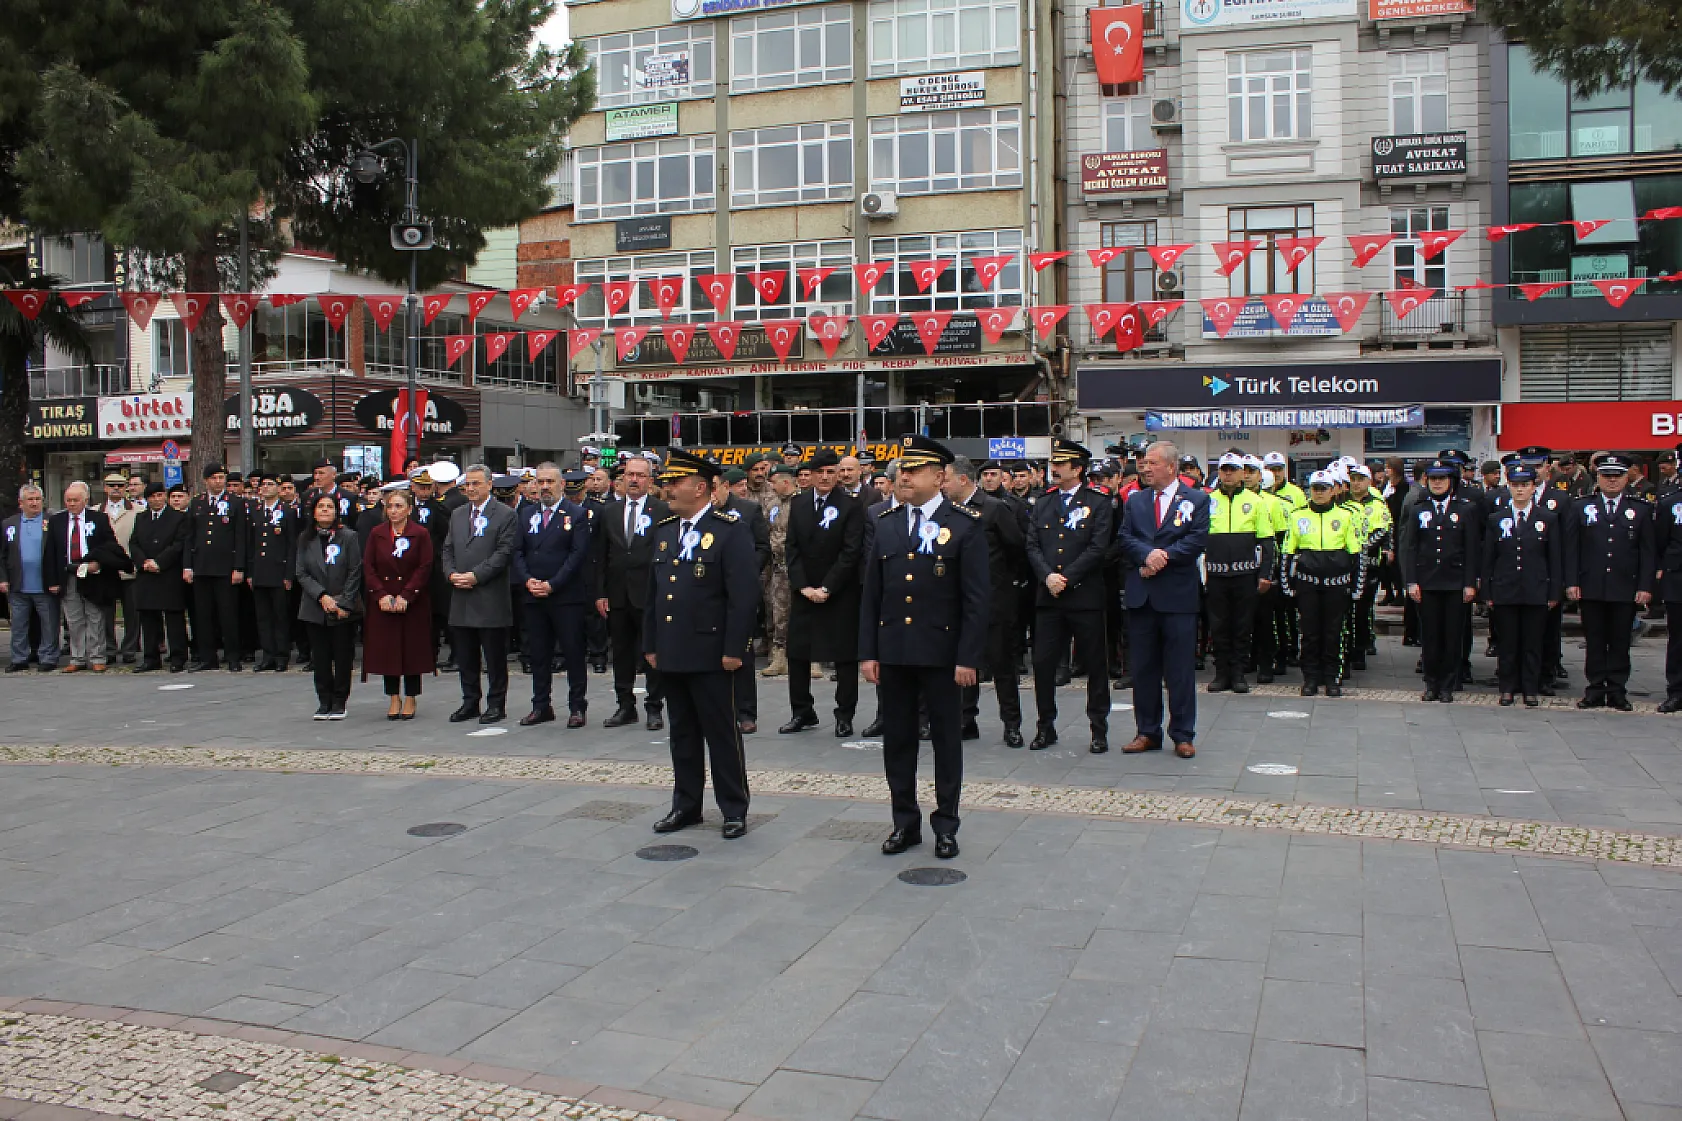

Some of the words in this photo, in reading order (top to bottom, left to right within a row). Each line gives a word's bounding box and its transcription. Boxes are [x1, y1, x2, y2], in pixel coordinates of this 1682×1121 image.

[1378, 7, 1414, 16] GENEL
[1405, 148, 1458, 159] AVUKAT
[1096, 166, 1161, 177] AVUKAT
[1375, 163, 1405, 174] FUAT
[1408, 160, 1466, 172] SARIKAYA
[750, 363, 778, 373] ANIT
[784, 361, 826, 372] TERME
[882, 359, 918, 369] KEBAP
[1234, 377, 1282, 394] Türk
[1288, 376, 1379, 394] Telekom
[40, 405, 85, 421] TIRAŞ
[121, 397, 184, 418] birtat
[1161, 411, 1210, 428] SINIRSIZ
[1244, 408, 1298, 426] İNTERNET
[1299, 406, 1355, 427] BAŞVURU
[1357, 406, 1409, 424] NOKTASI
[33, 423, 93, 438] DÜNYASI
[1218, 431, 1250, 441] tivibu
